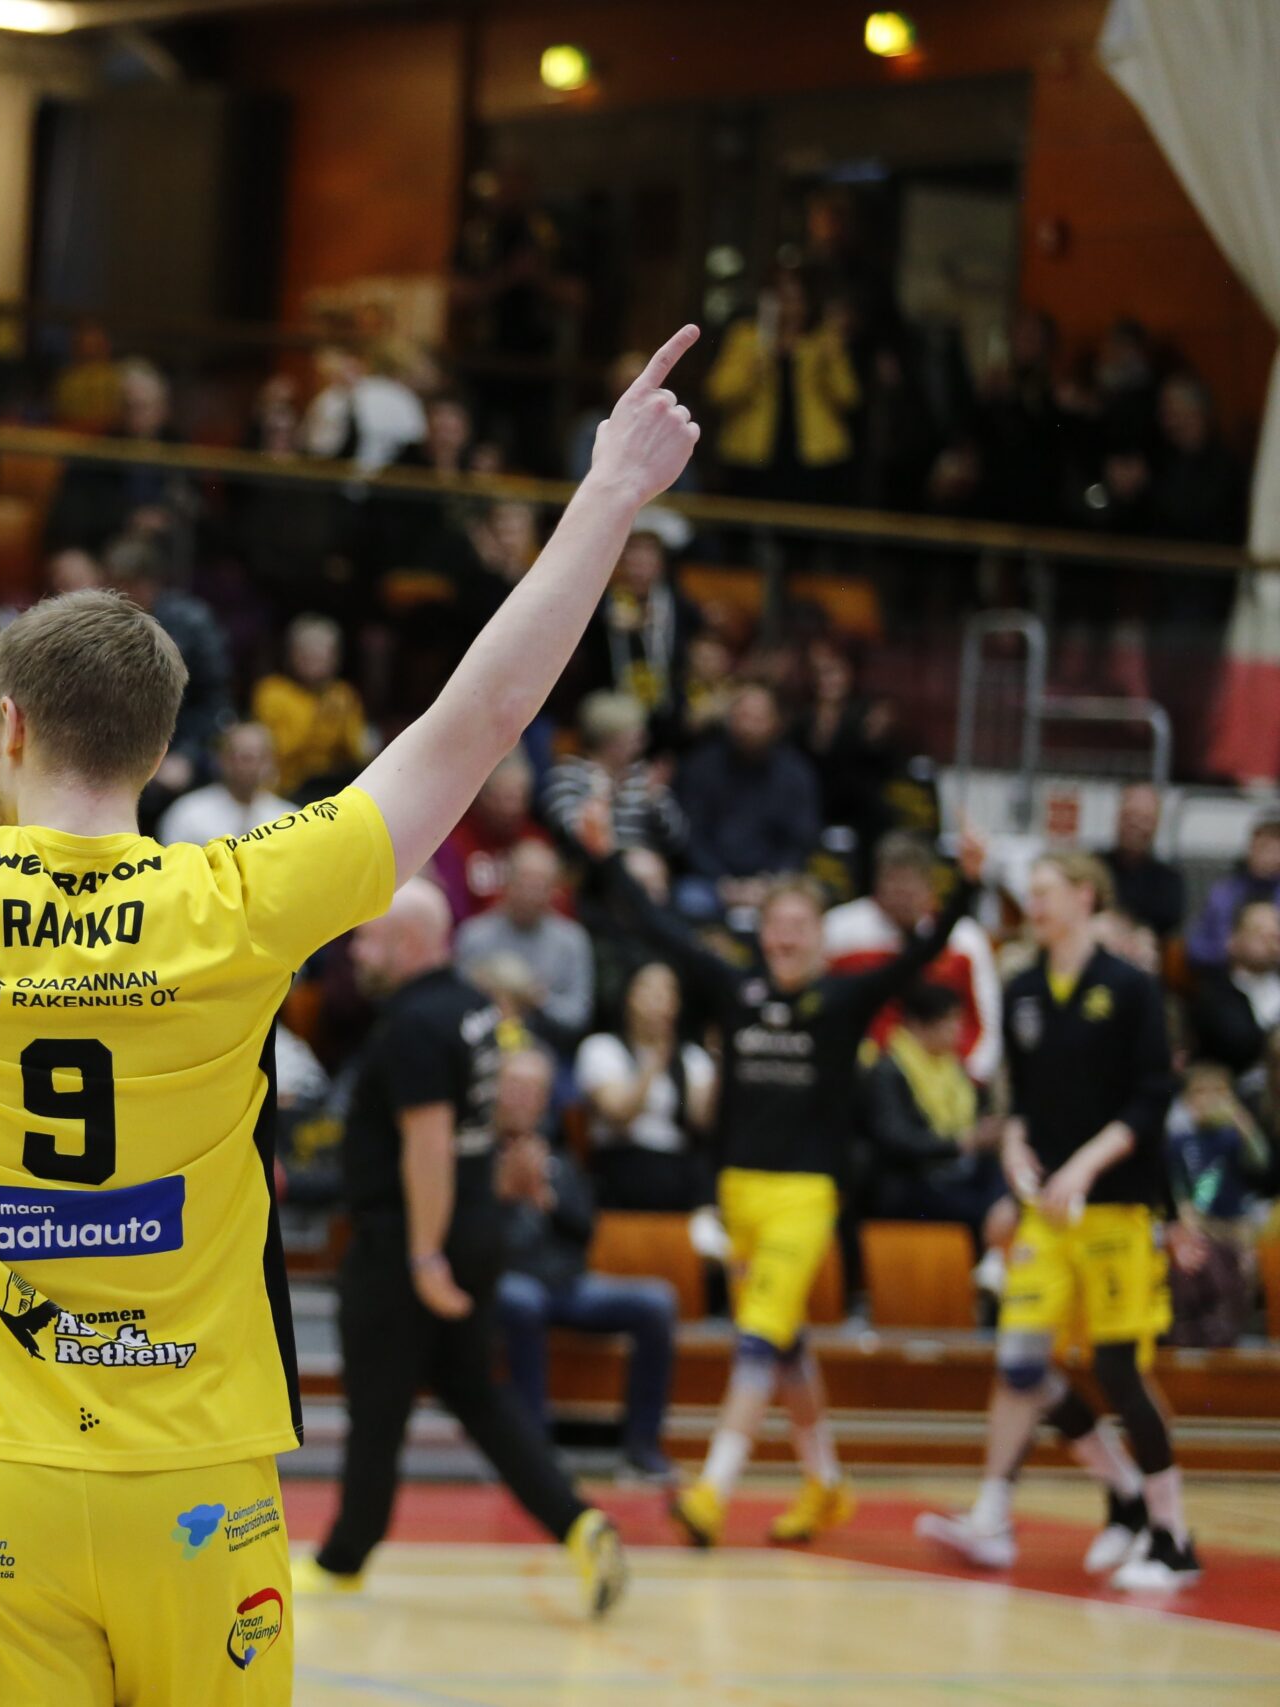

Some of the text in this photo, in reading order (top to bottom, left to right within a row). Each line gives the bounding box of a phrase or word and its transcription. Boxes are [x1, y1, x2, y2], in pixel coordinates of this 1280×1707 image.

[16, 970, 158, 991] OJARANNAN
[12, 987, 180, 1008] RAKENNUS OY
[21, 1038, 116, 1185] 9
[68, 1309, 146, 1324] uomen
[55, 1337, 196, 1368] Retkeily
